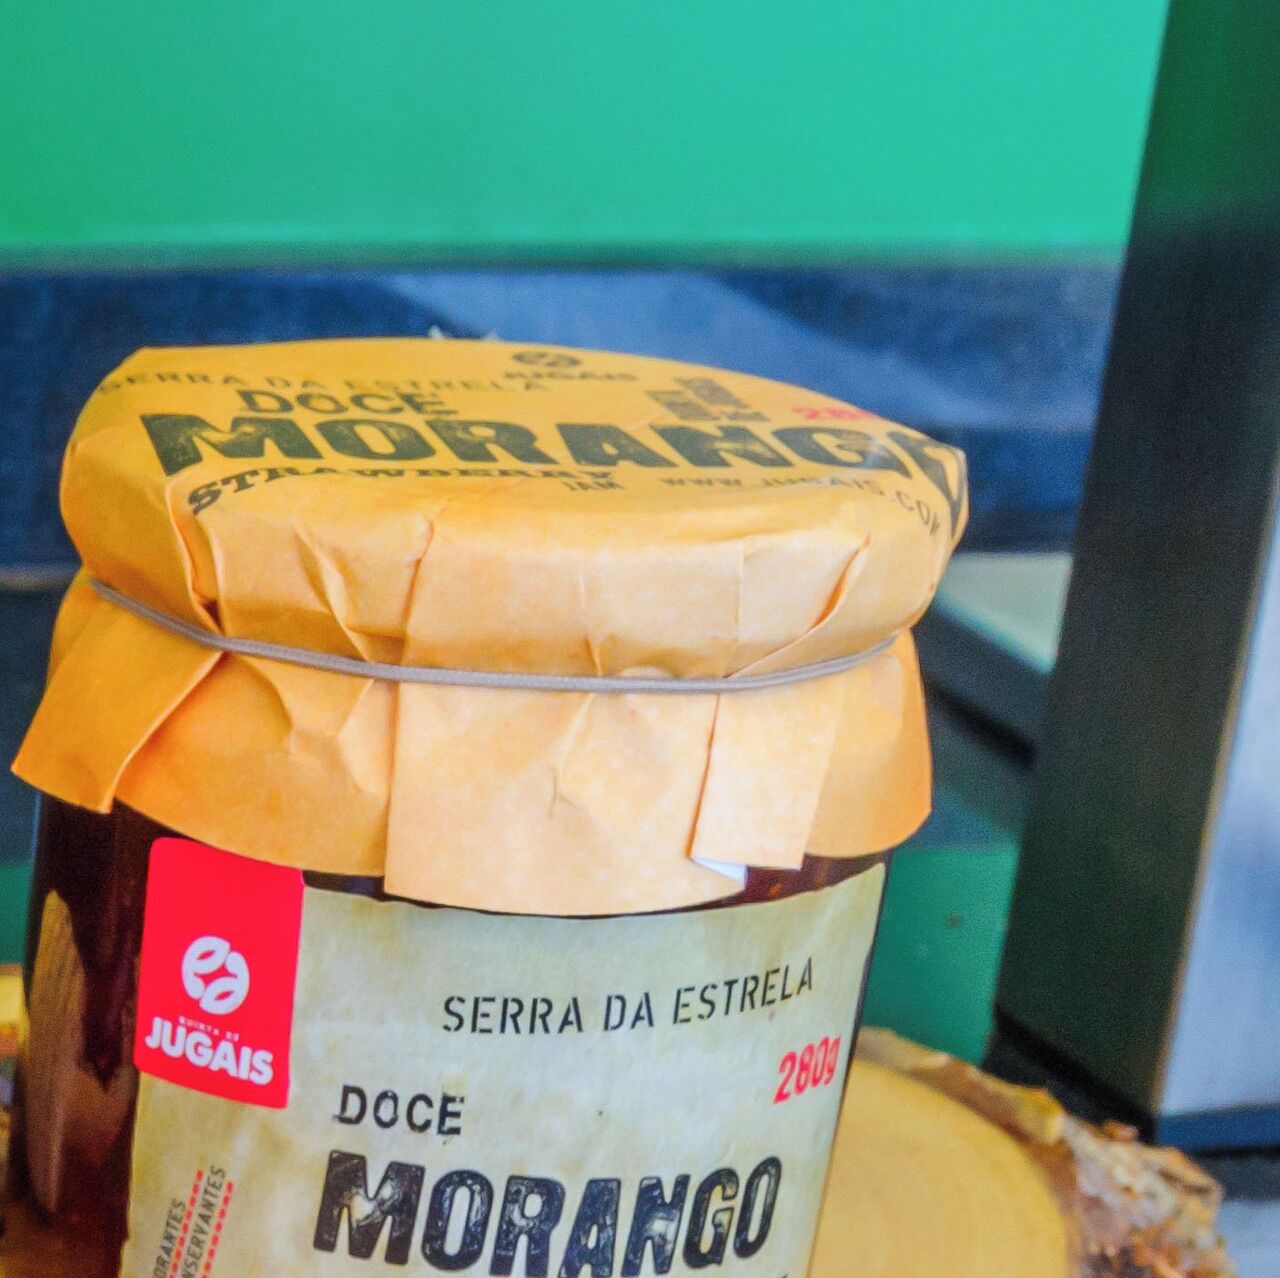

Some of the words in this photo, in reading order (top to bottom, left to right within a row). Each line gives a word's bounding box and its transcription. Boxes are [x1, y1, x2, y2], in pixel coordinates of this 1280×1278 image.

[236, 389, 460, 417] DOCE
[187, 467, 613, 517] STRAWBERRY
[441, 995, 584, 1035] SERRA
[602, 991, 655, 1032] DA
[671, 956, 814, 1025] ESTRELA
[144, 1016, 274, 1086] JUGAIS
[772, 1035, 842, 1105] 280g
[333, 1085, 465, 1137] DOCE
